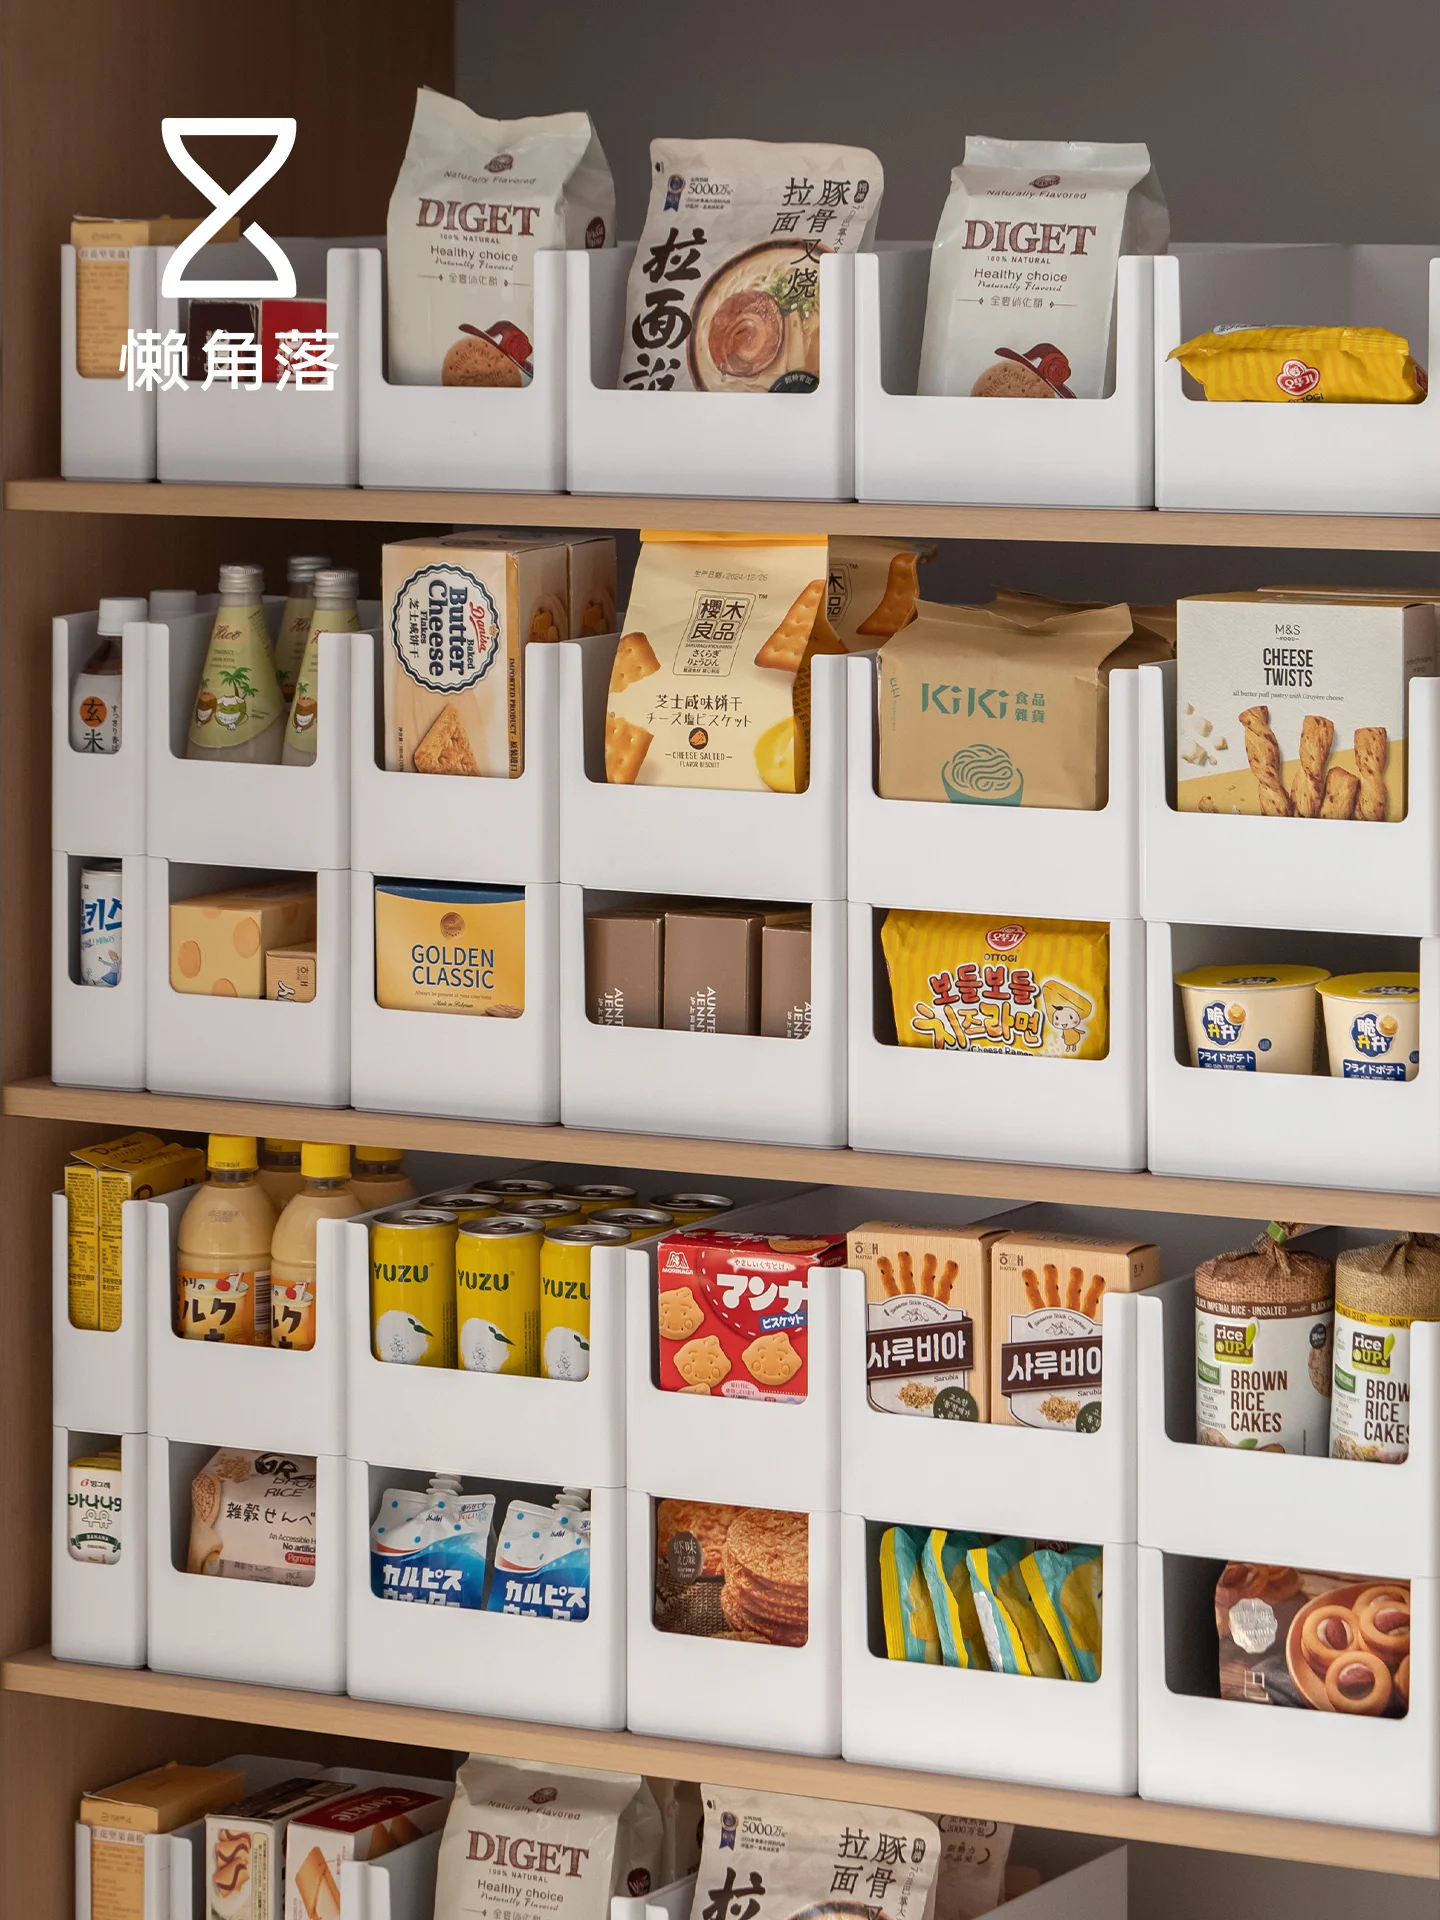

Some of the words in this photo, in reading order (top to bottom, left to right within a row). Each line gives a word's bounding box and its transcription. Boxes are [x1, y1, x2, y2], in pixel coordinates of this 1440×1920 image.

[986, 189, 1035, 199] Naturally
[1038, 190, 1087, 200] Flavored
[415, 196, 541, 237] DIGET
[462, 234, 500, 245] NATURAL
[961, 219, 1097, 256] DIGET
[430, 245, 476, 261] Healthy
[479, 250, 518, 263] choice
[1011, 256, 1051, 264] NATURAL
[974, 268, 1023, 282] Healthy
[1026, 270, 1068, 283] choice
[420, 610, 428, 645] Flakes
[428, 579, 449, 677] Cheese
[449, 586, 468, 677] Butter
[468, 601, 487, 654] Danisa
[690, 621, 735, 641] 良品
[1275, 624, 1301, 636] M&S
[466, 638, 476, 670] Baked
[1263, 647, 1314, 668] CHEESE
[1264, 668, 1313, 687] TWISTS
[655, 693, 743, 712] 芝士咸味饼干
[1014, 690, 1046, 708] 食品
[1240, 690, 1258, 698] butter
[1270, 692, 1289, 700] pastry
[1325, 694, 1345, 702] cheese
[82, 698, 105, 753] 玄米
[645, 711, 753, 728] チーズ塩ビスケット
[672, 751, 698, 760] CHEESE
[699, 752, 725, 761] SALTED
[411, 944, 495, 968] GOLDEN
[983, 953, 1018, 962] OTTOGI
[411, 965, 495, 990] CLASSIC
[928, 963, 1040, 1006] 보들보들
[912, 1001, 1042, 1050] 치즈라면
[373, 1261, 429, 1284] YUZU
[457, 1267, 509, 1292] YUZU
[662, 1267, 694, 1276] MORINAGA
[716, 1273, 809, 1315] マンナ
[1206, 1300, 1231, 1314] IMPERIAL
[1231, 1305, 1246, 1316] RICE
[1252, 1306, 1288, 1316] UNSALTED
[762, 1314, 805, 1331] ビスケット
[1216, 1326, 1244, 1341] rice
[1354, 1334, 1383, 1350] rice
[867, 1330, 967, 1369] 사루비아
[1231, 1369, 1288, 1391] BROWN
[1231, 1390, 1265, 1412] RICE
[1365, 1399, 1400, 1423] RICE
[1231, 1411, 1282, 1433] CAKES
[264, 1487, 306, 1498] RICE
[86, 1534, 109, 1542] BANANA
[268, 1532, 278, 1541] An
[278, 1533, 310, 1545] Accessible
[282, 1542, 294, 1551] No
[382, 1564, 463, 1593] カルピス
[505, 1579, 587, 1609] カルピス
[487, 1800, 534, 1813] Naturally
[465, 1829, 590, 1879] DIGET
[511, 1871, 549, 1884] NATURAL
[477, 1879, 522, 1898] Healthy
[526, 1888, 564, 1903] choice
